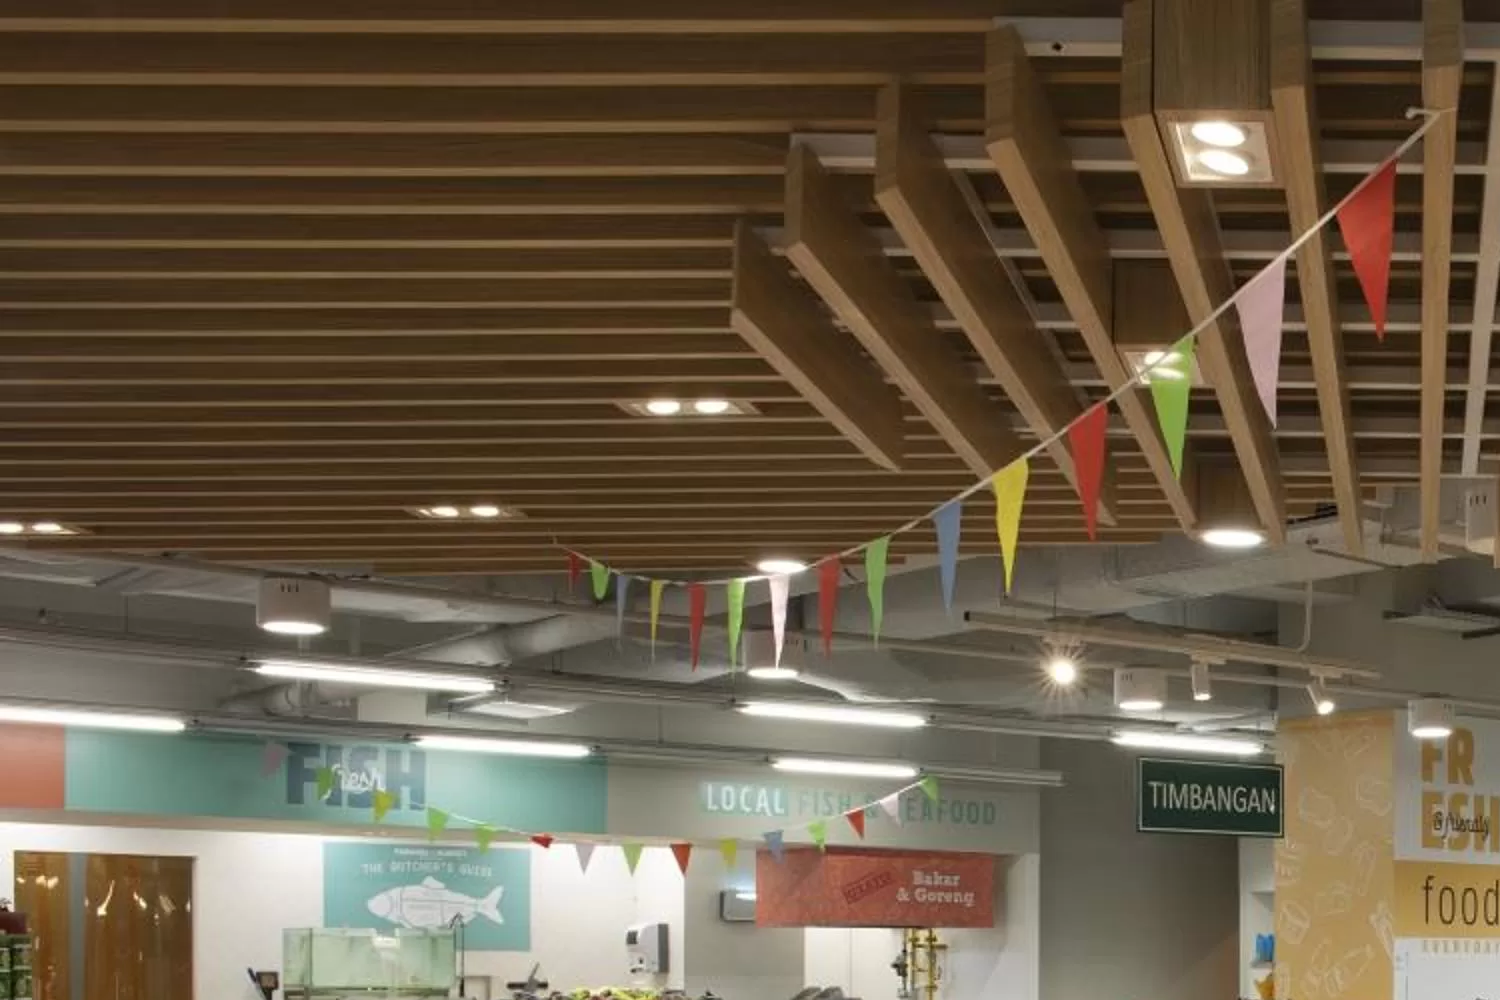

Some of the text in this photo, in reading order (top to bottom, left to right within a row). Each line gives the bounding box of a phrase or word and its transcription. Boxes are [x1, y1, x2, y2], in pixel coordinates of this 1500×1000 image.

[287, 742, 427, 811] FISH
[706, 784, 785, 816] LOCAL
[897, 796, 996, 825] EAFOOD
[1148, 781, 1276, 815] TIMBANGAN
[912, 870, 961, 886] Bakar
[914, 888, 975, 907] Goreng
[1422, 875, 1500, 926] food
